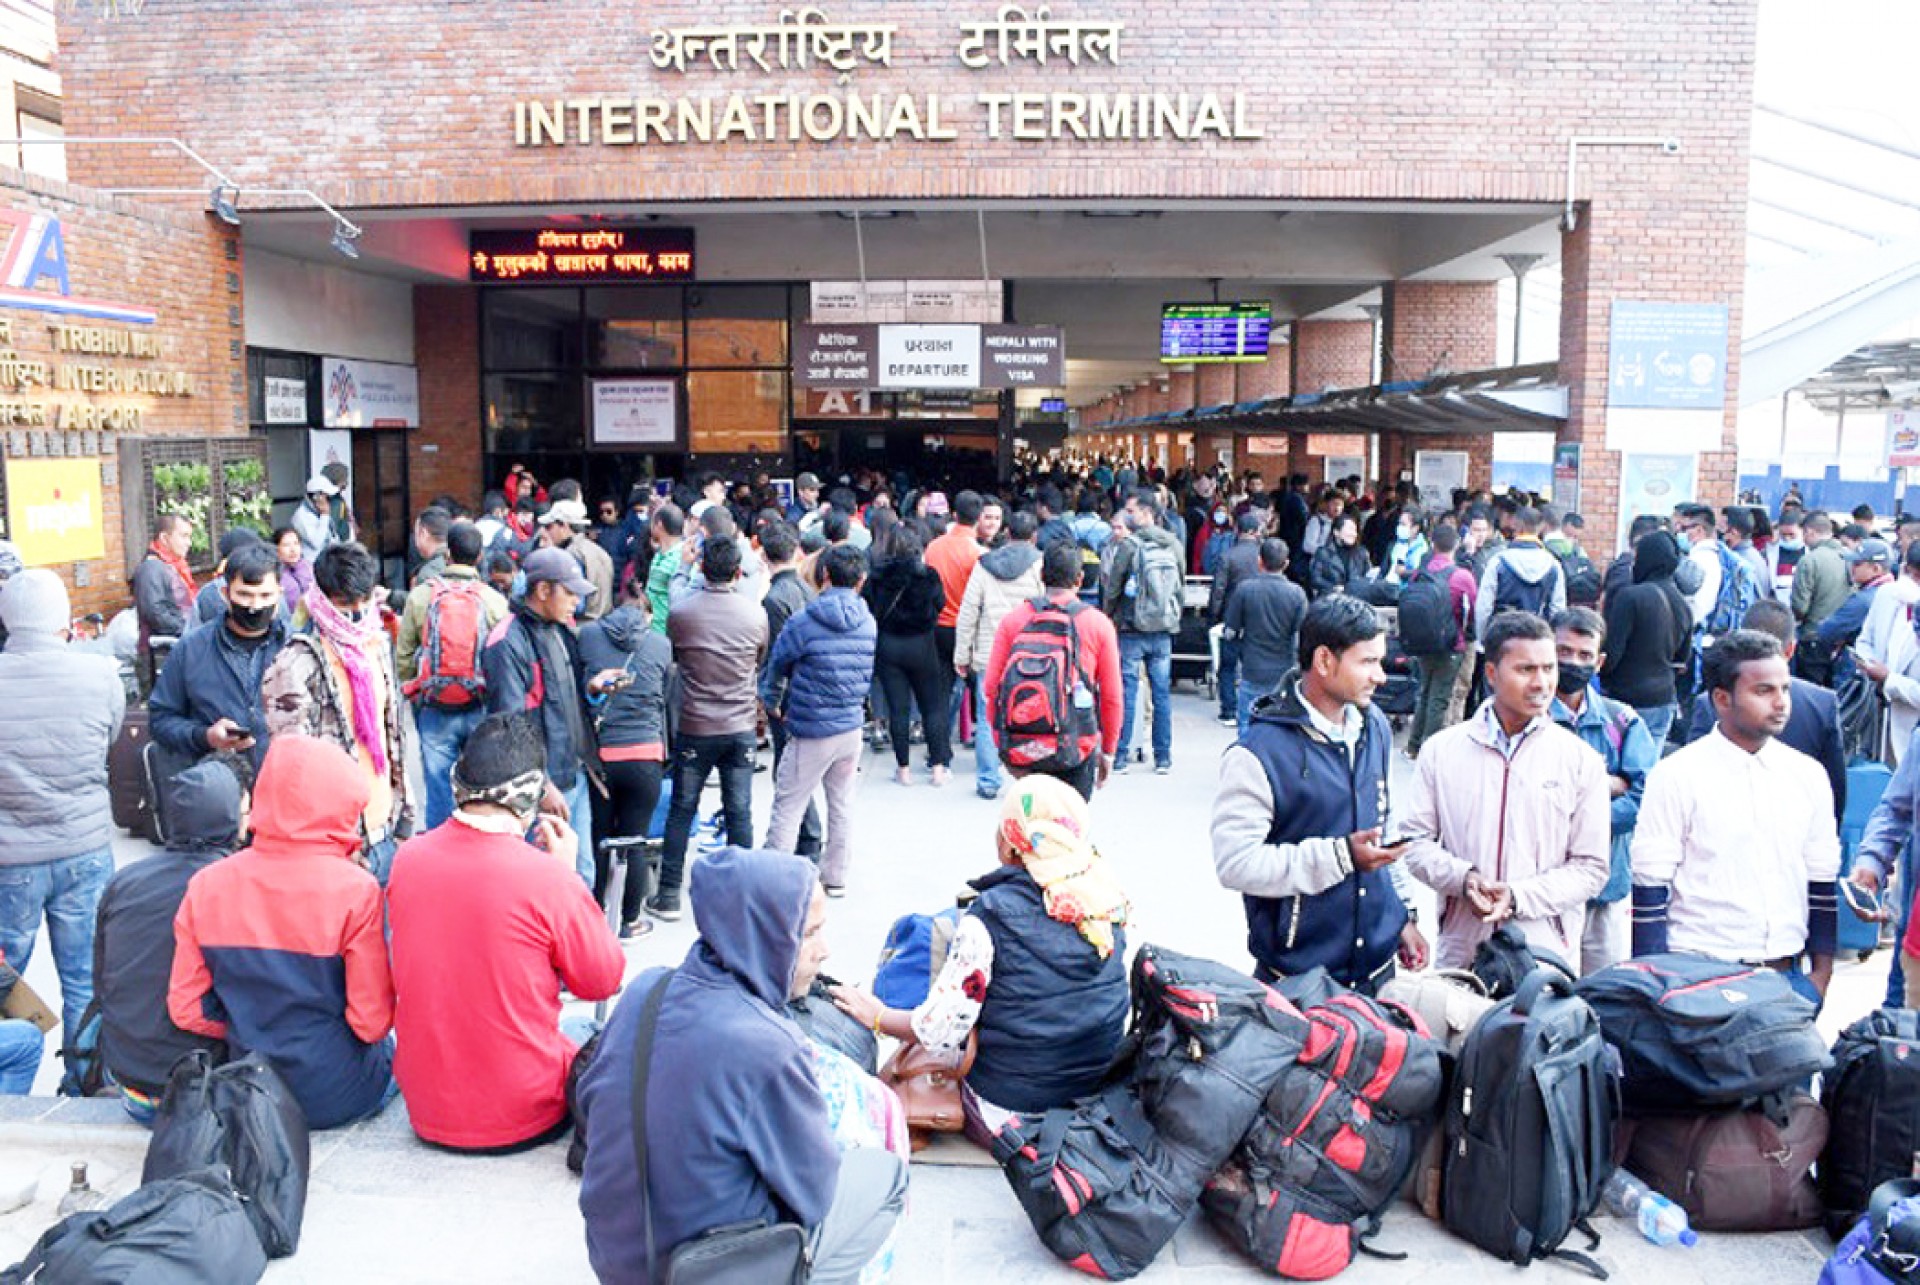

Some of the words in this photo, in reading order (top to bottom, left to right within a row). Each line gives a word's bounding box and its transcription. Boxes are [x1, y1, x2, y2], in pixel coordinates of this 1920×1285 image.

[959, 5, 1124, 68] टर्मिनल
[514, 93, 958, 145] INTERNATIONAL
[977, 92, 1264, 140] TERMINAL
[985, 336, 1025, 348] NEPALI
[1028, 336, 1058, 348] WITH
[993, 352, 1049, 364] WORKING
[888, 363, 970, 377] DEPARTURE
[1007, 370, 1036, 381] VISA
[819, 387, 871, 413] A1
